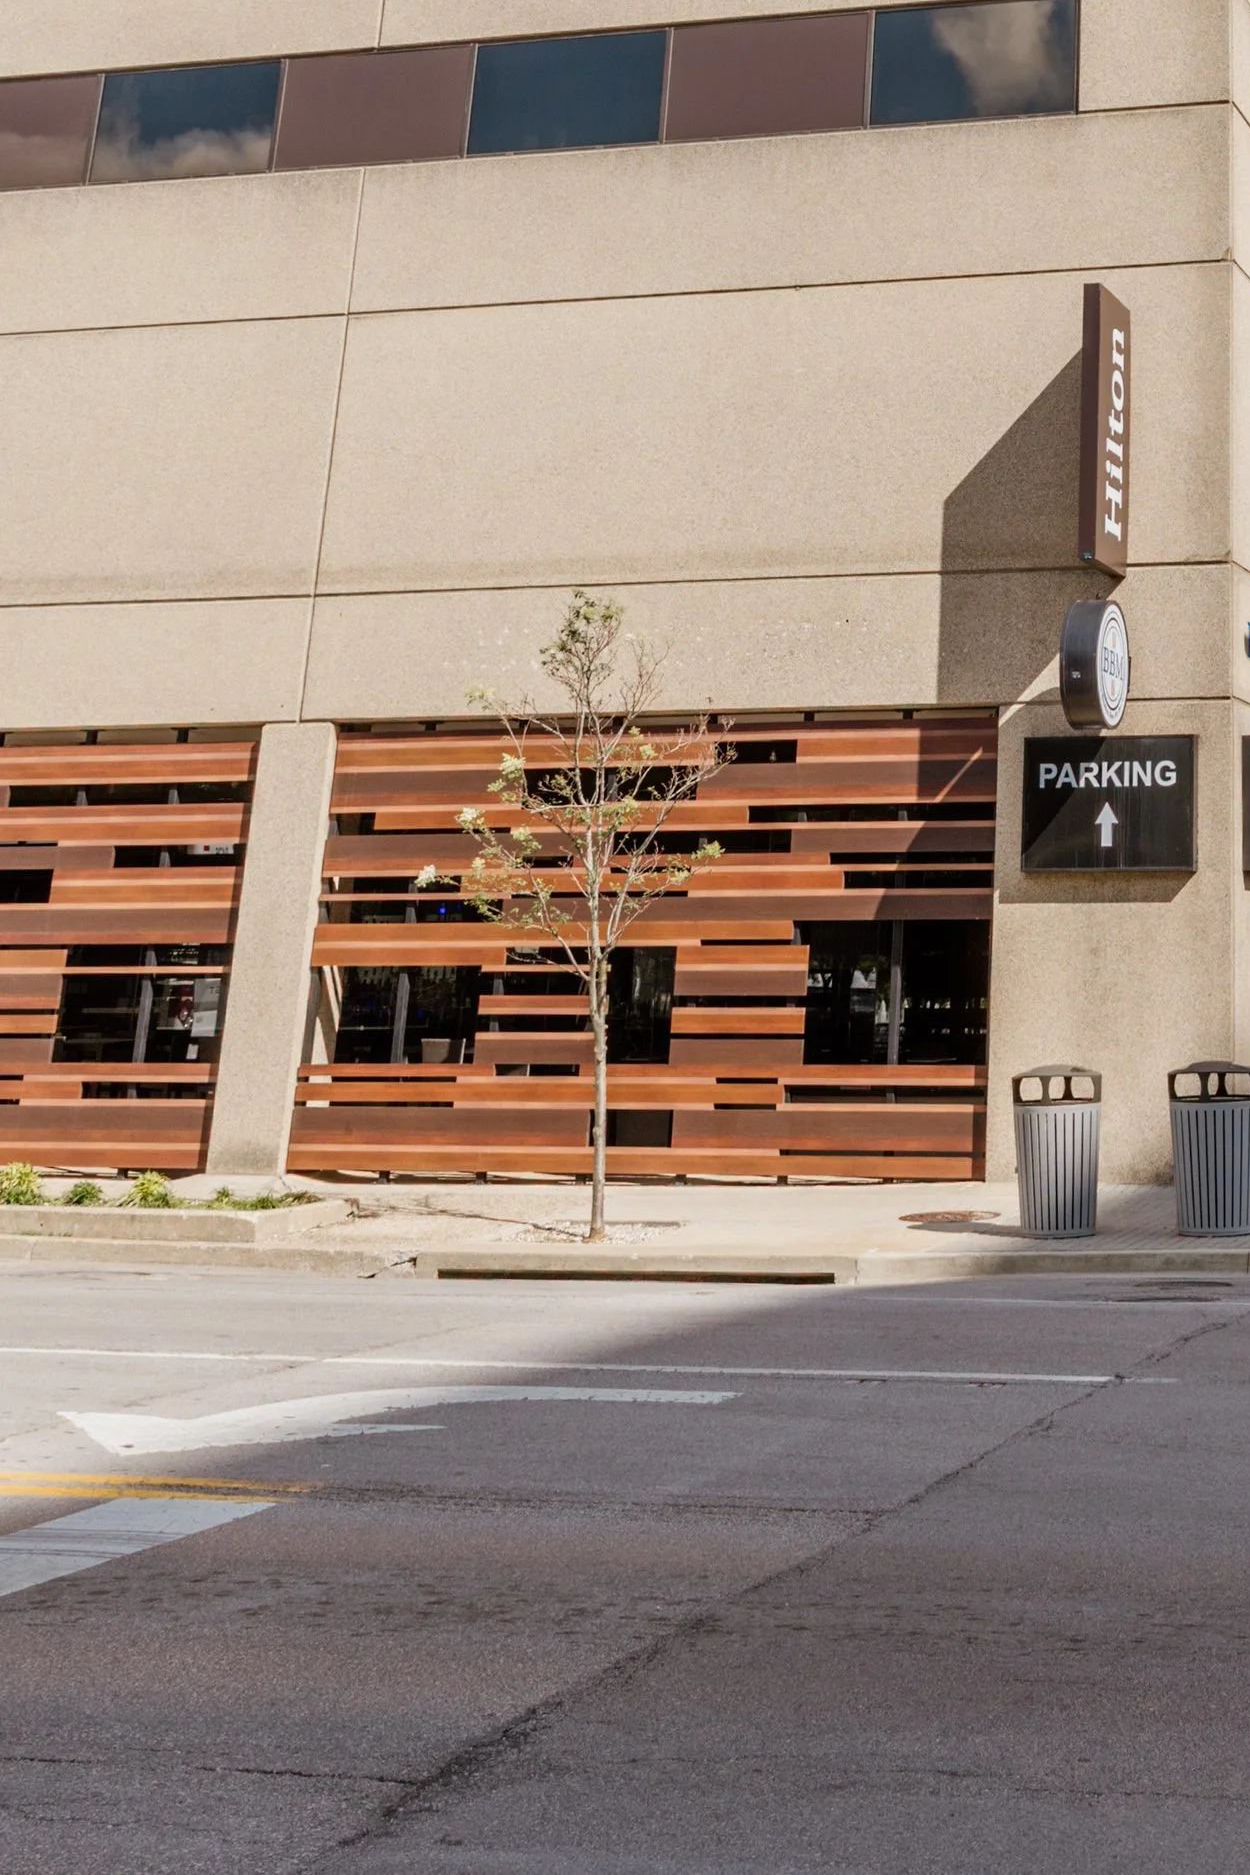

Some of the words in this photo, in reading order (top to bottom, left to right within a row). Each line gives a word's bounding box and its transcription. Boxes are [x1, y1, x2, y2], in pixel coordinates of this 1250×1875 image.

[1104, 328, 1125, 541] Hilton
[1103, 646, 1124, 681] BBM
[1039, 760, 1177, 789] PARKING
